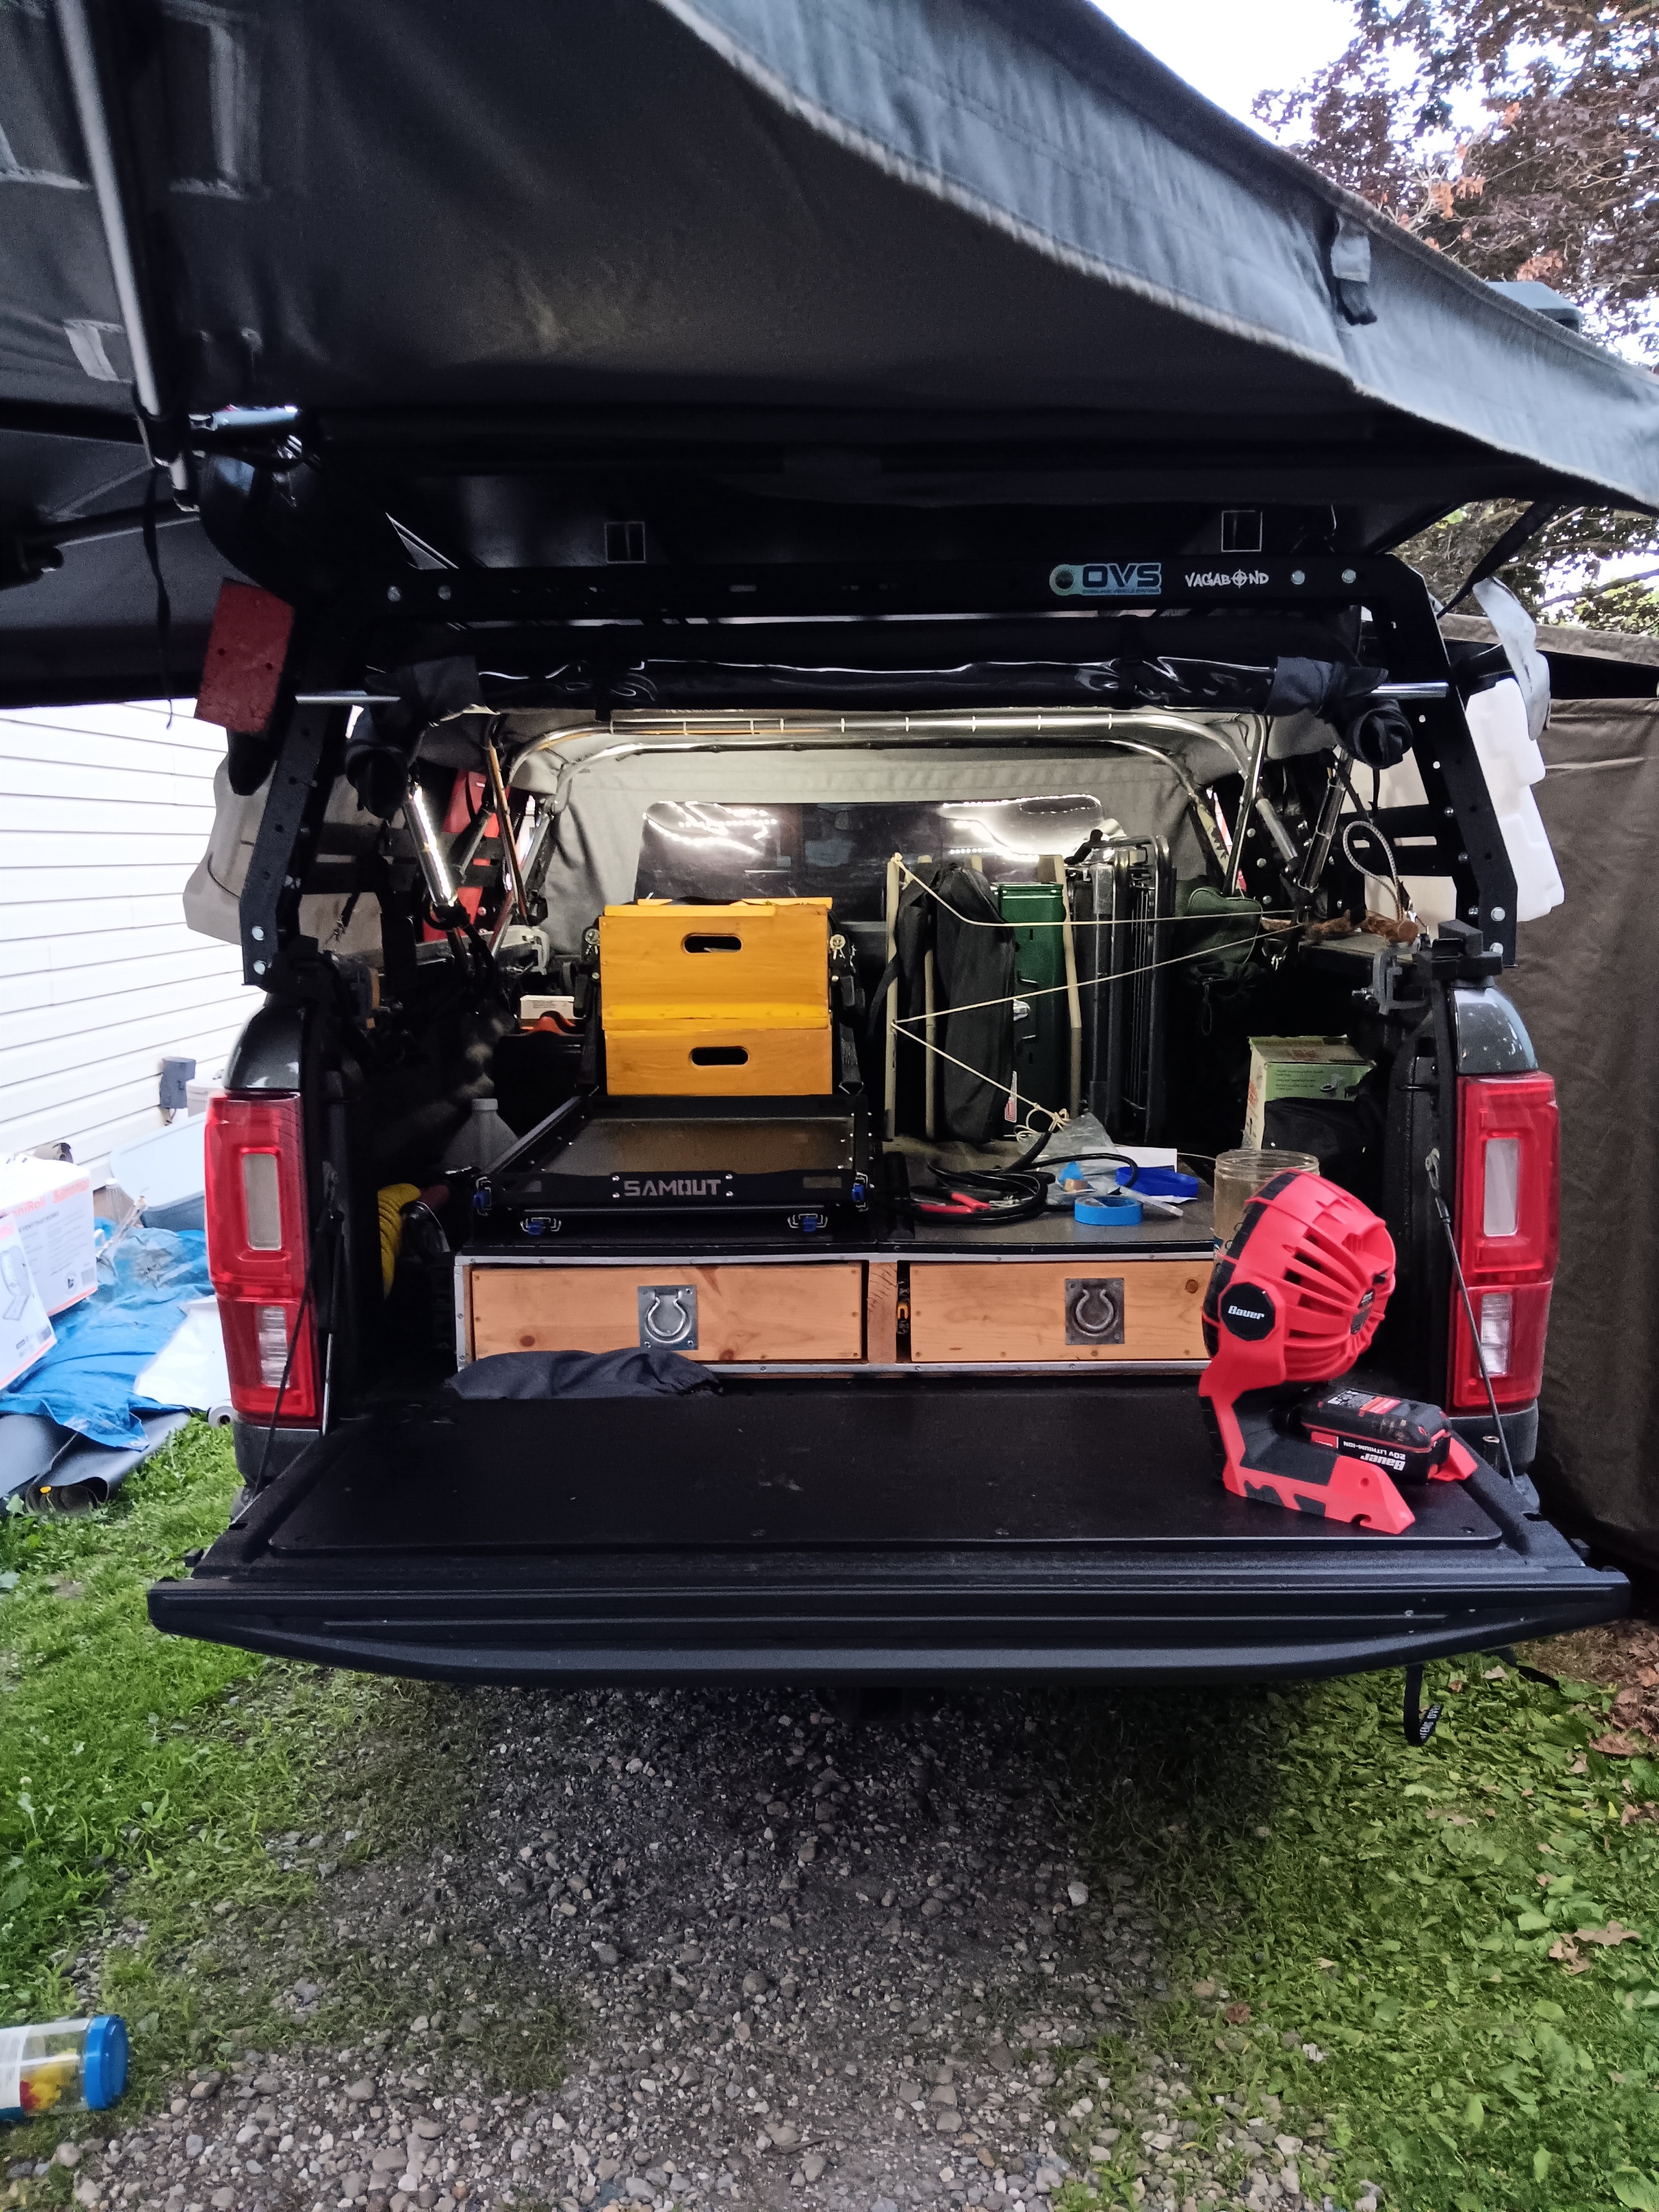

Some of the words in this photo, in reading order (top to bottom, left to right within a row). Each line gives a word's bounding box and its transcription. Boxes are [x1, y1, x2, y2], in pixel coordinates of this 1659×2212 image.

[1082, 563, 1161, 588] OVS
[1185, 569, 1269, 588] VAGABOND
[623, 1179, 721, 1196] SAMOUT
[1228, 1305, 1265, 1320] Bauer
[1360, 1452, 1406, 1471] Bauer
